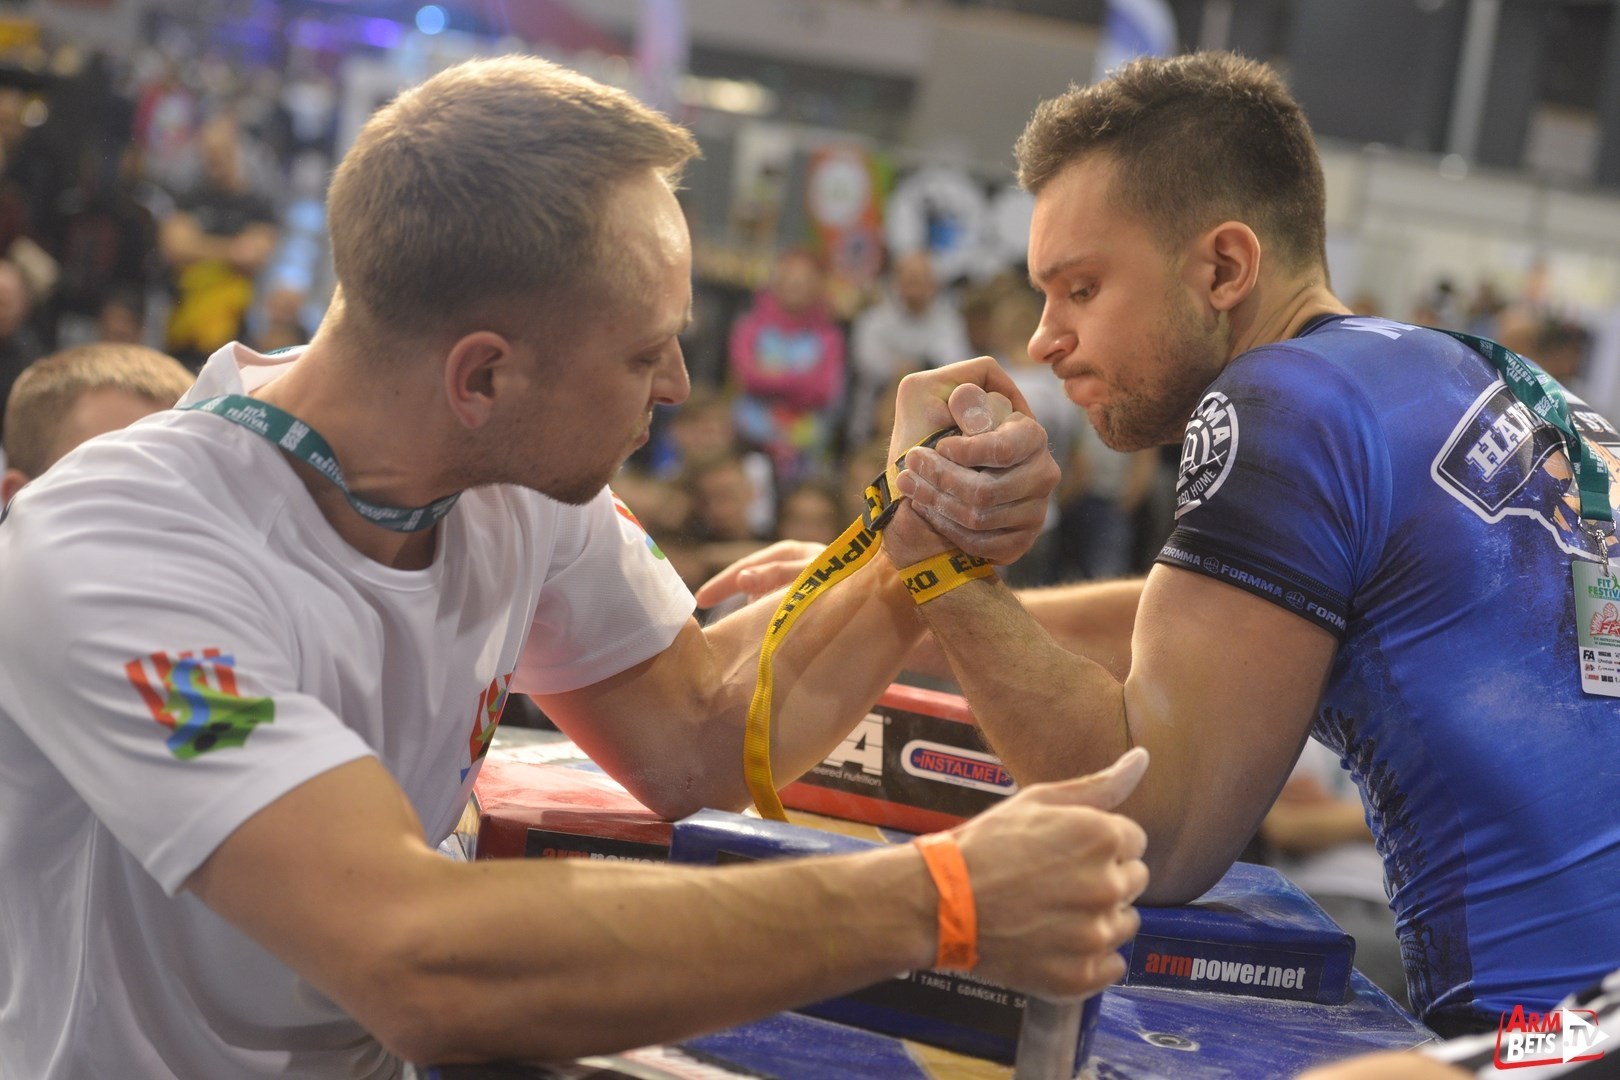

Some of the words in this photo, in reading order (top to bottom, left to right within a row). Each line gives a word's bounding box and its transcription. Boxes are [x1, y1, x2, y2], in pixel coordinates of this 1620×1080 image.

[1504, 352, 1535, 387] FESTIVAL
[225, 407, 270, 432] FESTIVAL
[1189, 469, 1217, 498] HOME
[1161, 545, 1200, 566] FORMMA
[1220, 563, 1283, 598] FORMMA
[1597, 578, 1611, 588] FIT
[1583, 649, 1595, 661] FA
[920, 974, 952, 992] TARGI
[1144, 952, 1306, 990] armpower.net
